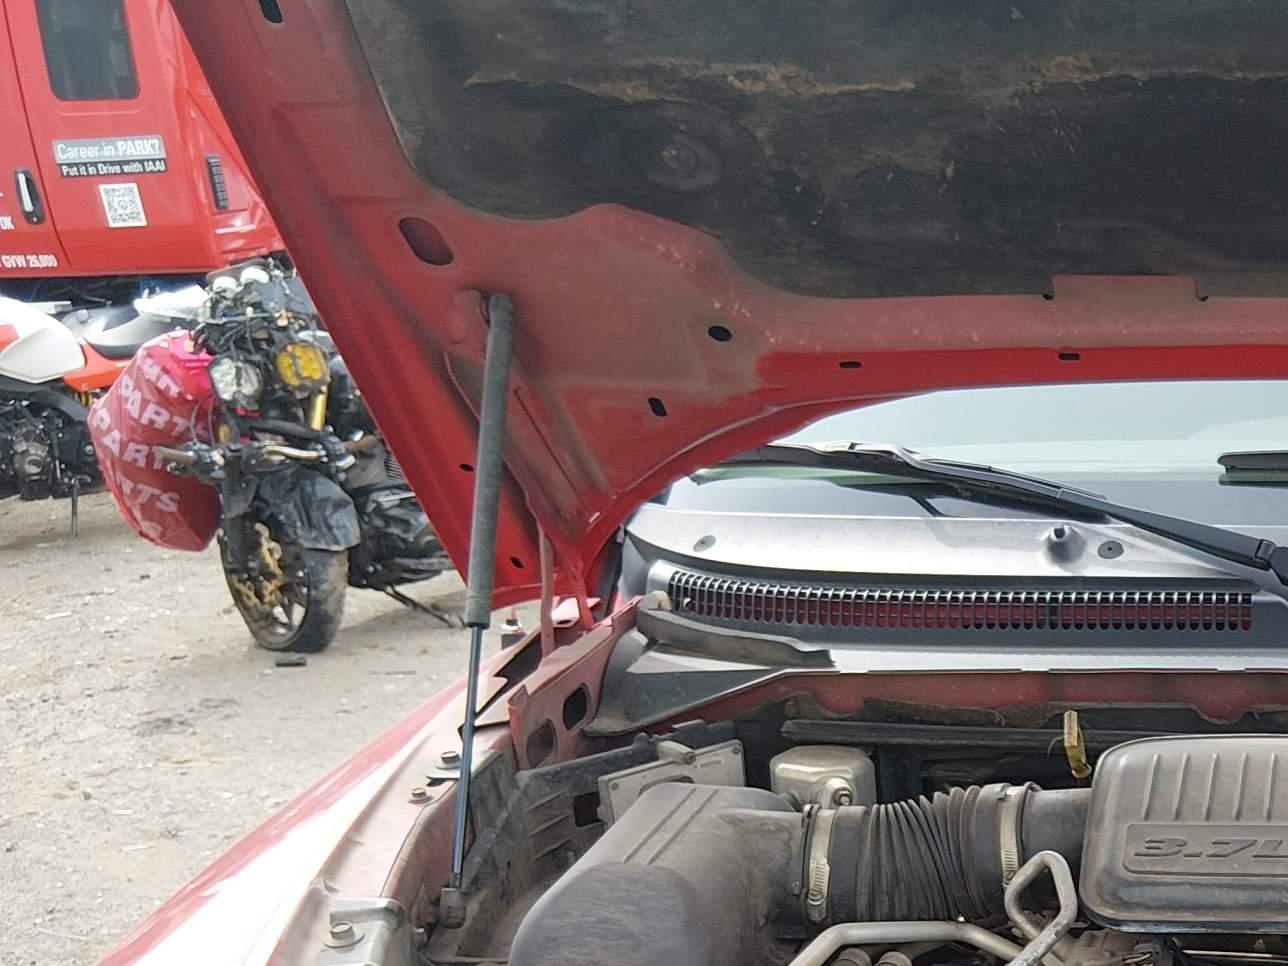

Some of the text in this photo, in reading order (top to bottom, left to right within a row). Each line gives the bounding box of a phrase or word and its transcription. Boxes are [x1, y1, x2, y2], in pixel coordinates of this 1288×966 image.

[57, 139, 160, 160] Career in PARK?
[62, 164, 79, 176] Put
[79, 163, 88, 175] it
[88, 164, 97, 175] in
[97, 162, 121, 175] Drive
[122, 161, 143, 173] with
